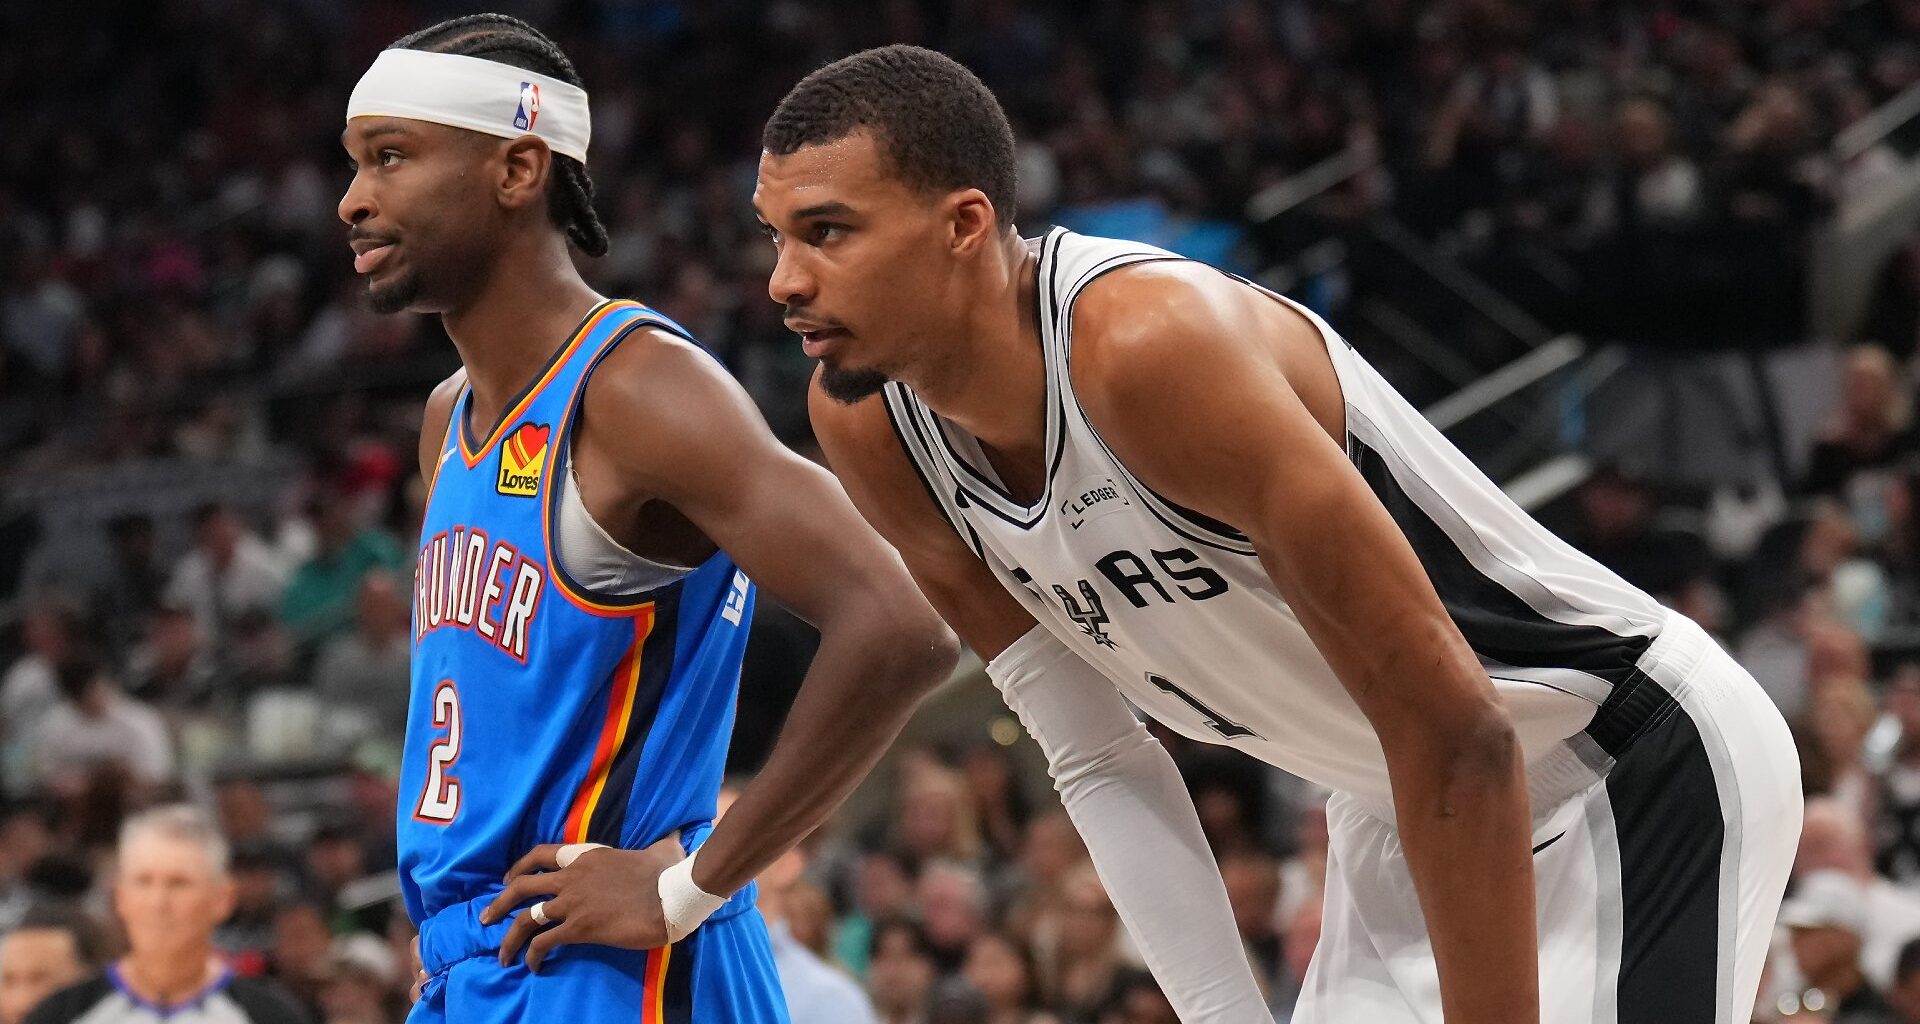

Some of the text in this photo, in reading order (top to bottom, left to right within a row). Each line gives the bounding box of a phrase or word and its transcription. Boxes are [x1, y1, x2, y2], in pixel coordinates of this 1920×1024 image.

[501, 468, 539, 491] Love's
[1071, 486, 1120, 515] LEDGER
[1011, 547, 1229, 652] URS
[1144, 671, 1268, 741] 1
[413, 679, 462, 825] 2
